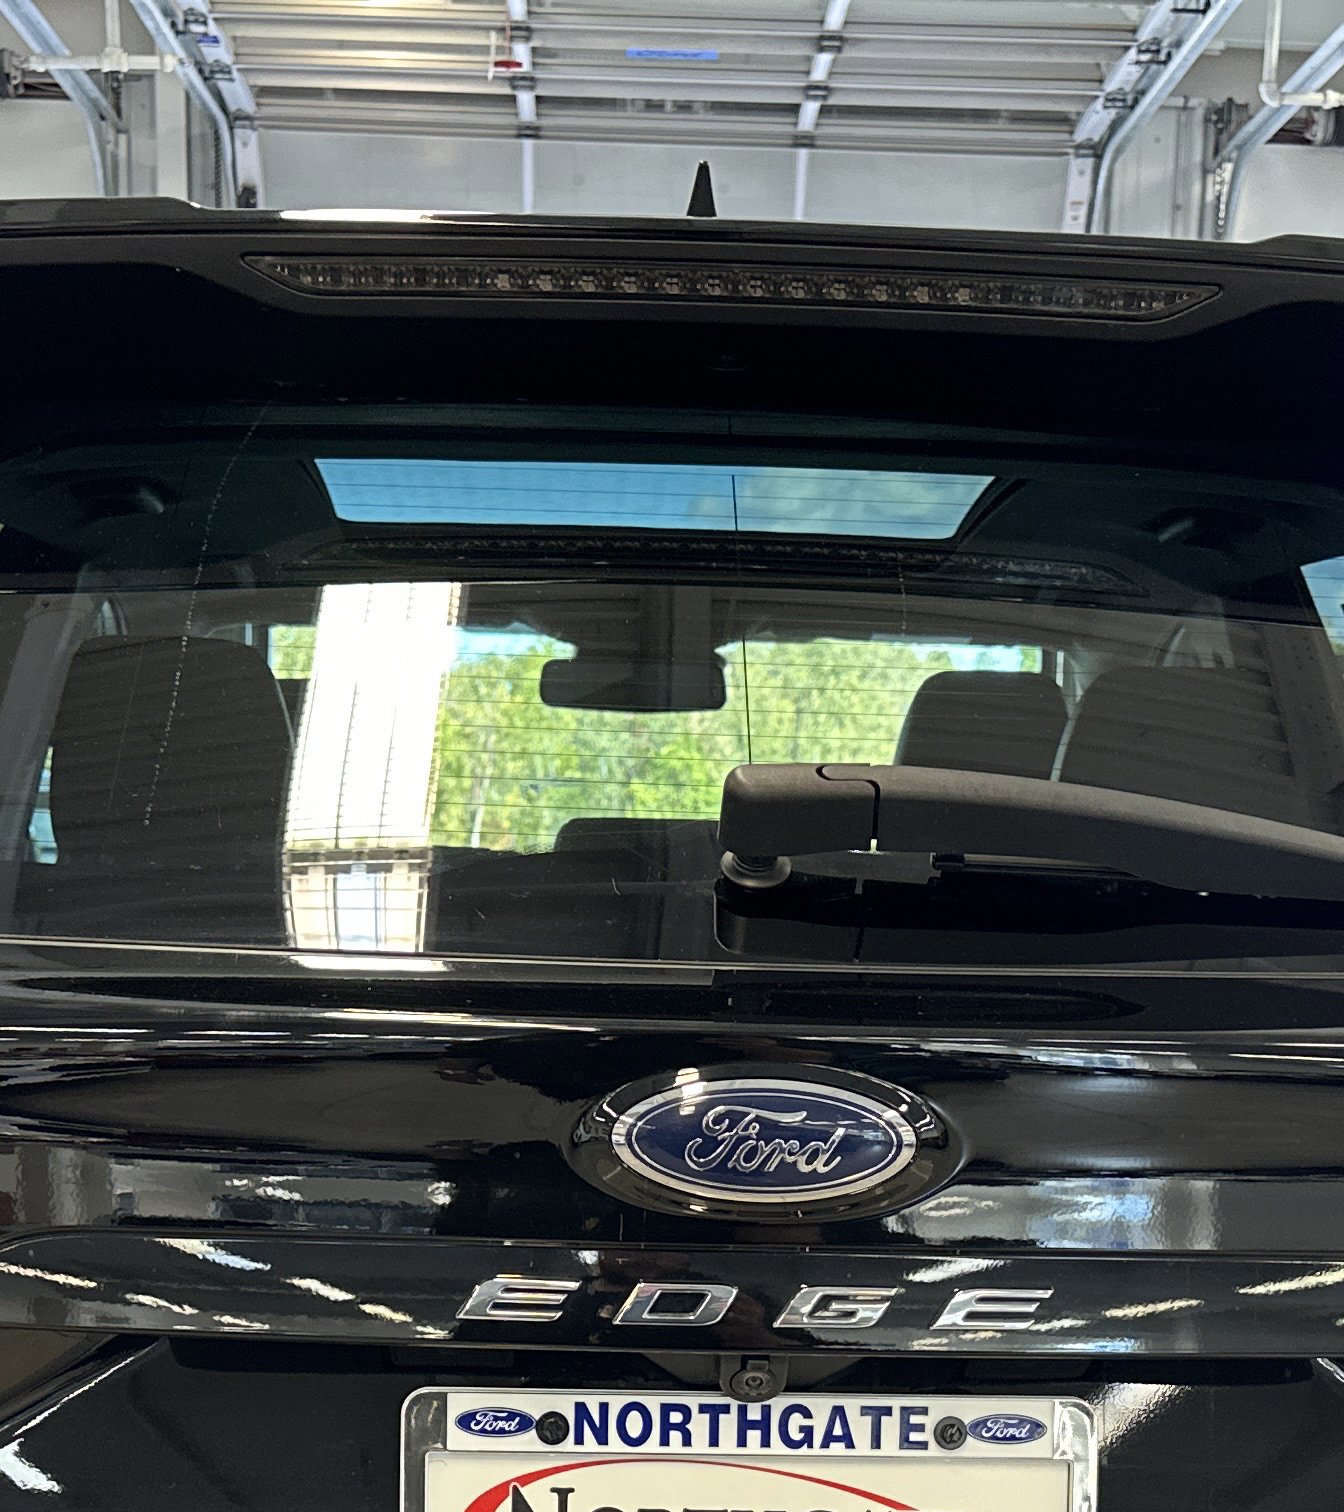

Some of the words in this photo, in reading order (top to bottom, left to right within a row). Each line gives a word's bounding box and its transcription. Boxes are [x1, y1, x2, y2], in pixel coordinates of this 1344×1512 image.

[684, 1104, 846, 1176] Ford
[455, 1273, 1056, 1331] EDGE
[573, 1400, 929, 1451] NORTHGATE
